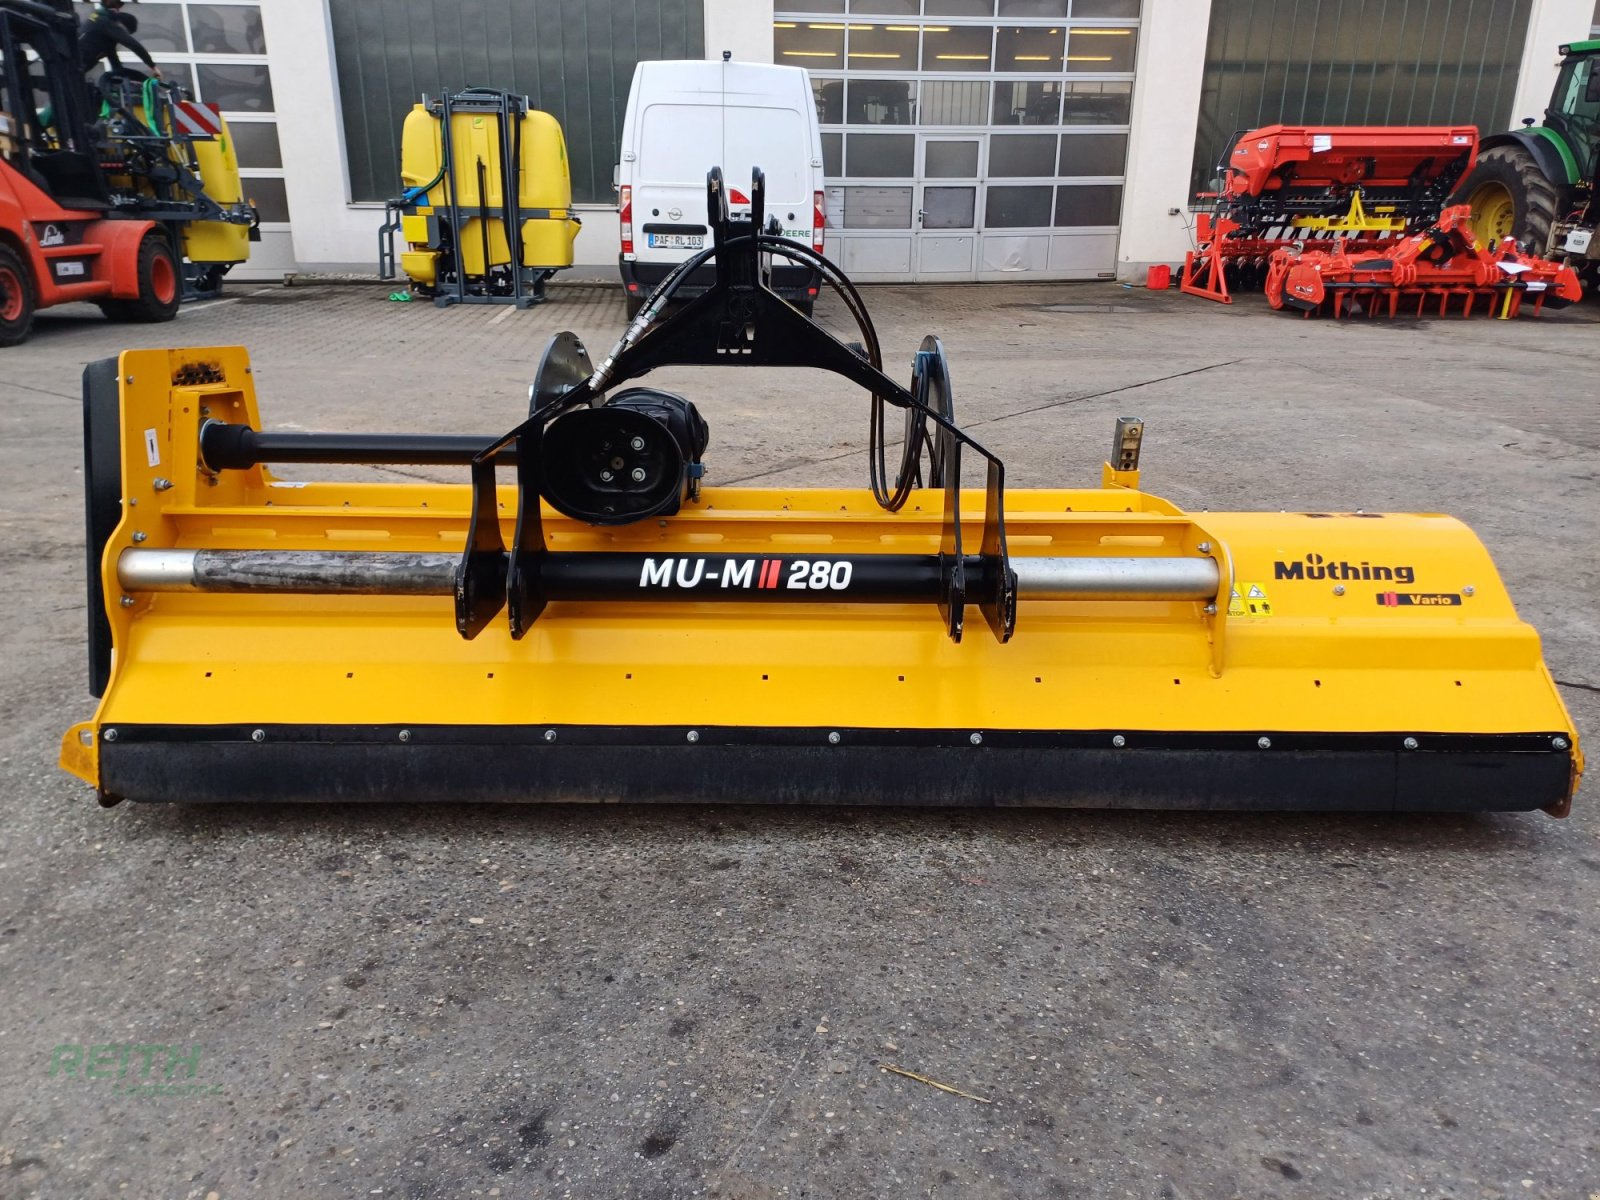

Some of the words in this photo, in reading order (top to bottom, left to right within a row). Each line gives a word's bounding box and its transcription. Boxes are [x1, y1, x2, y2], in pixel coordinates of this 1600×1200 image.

[654, 235, 669, 245] PAF
[675, 235, 685, 246] RL
[687, 236, 702, 246] 103
[786, 560, 853, 590] 280
[1273, 553, 1415, 584] Müthing
[1409, 595, 1452, 605] Vario
